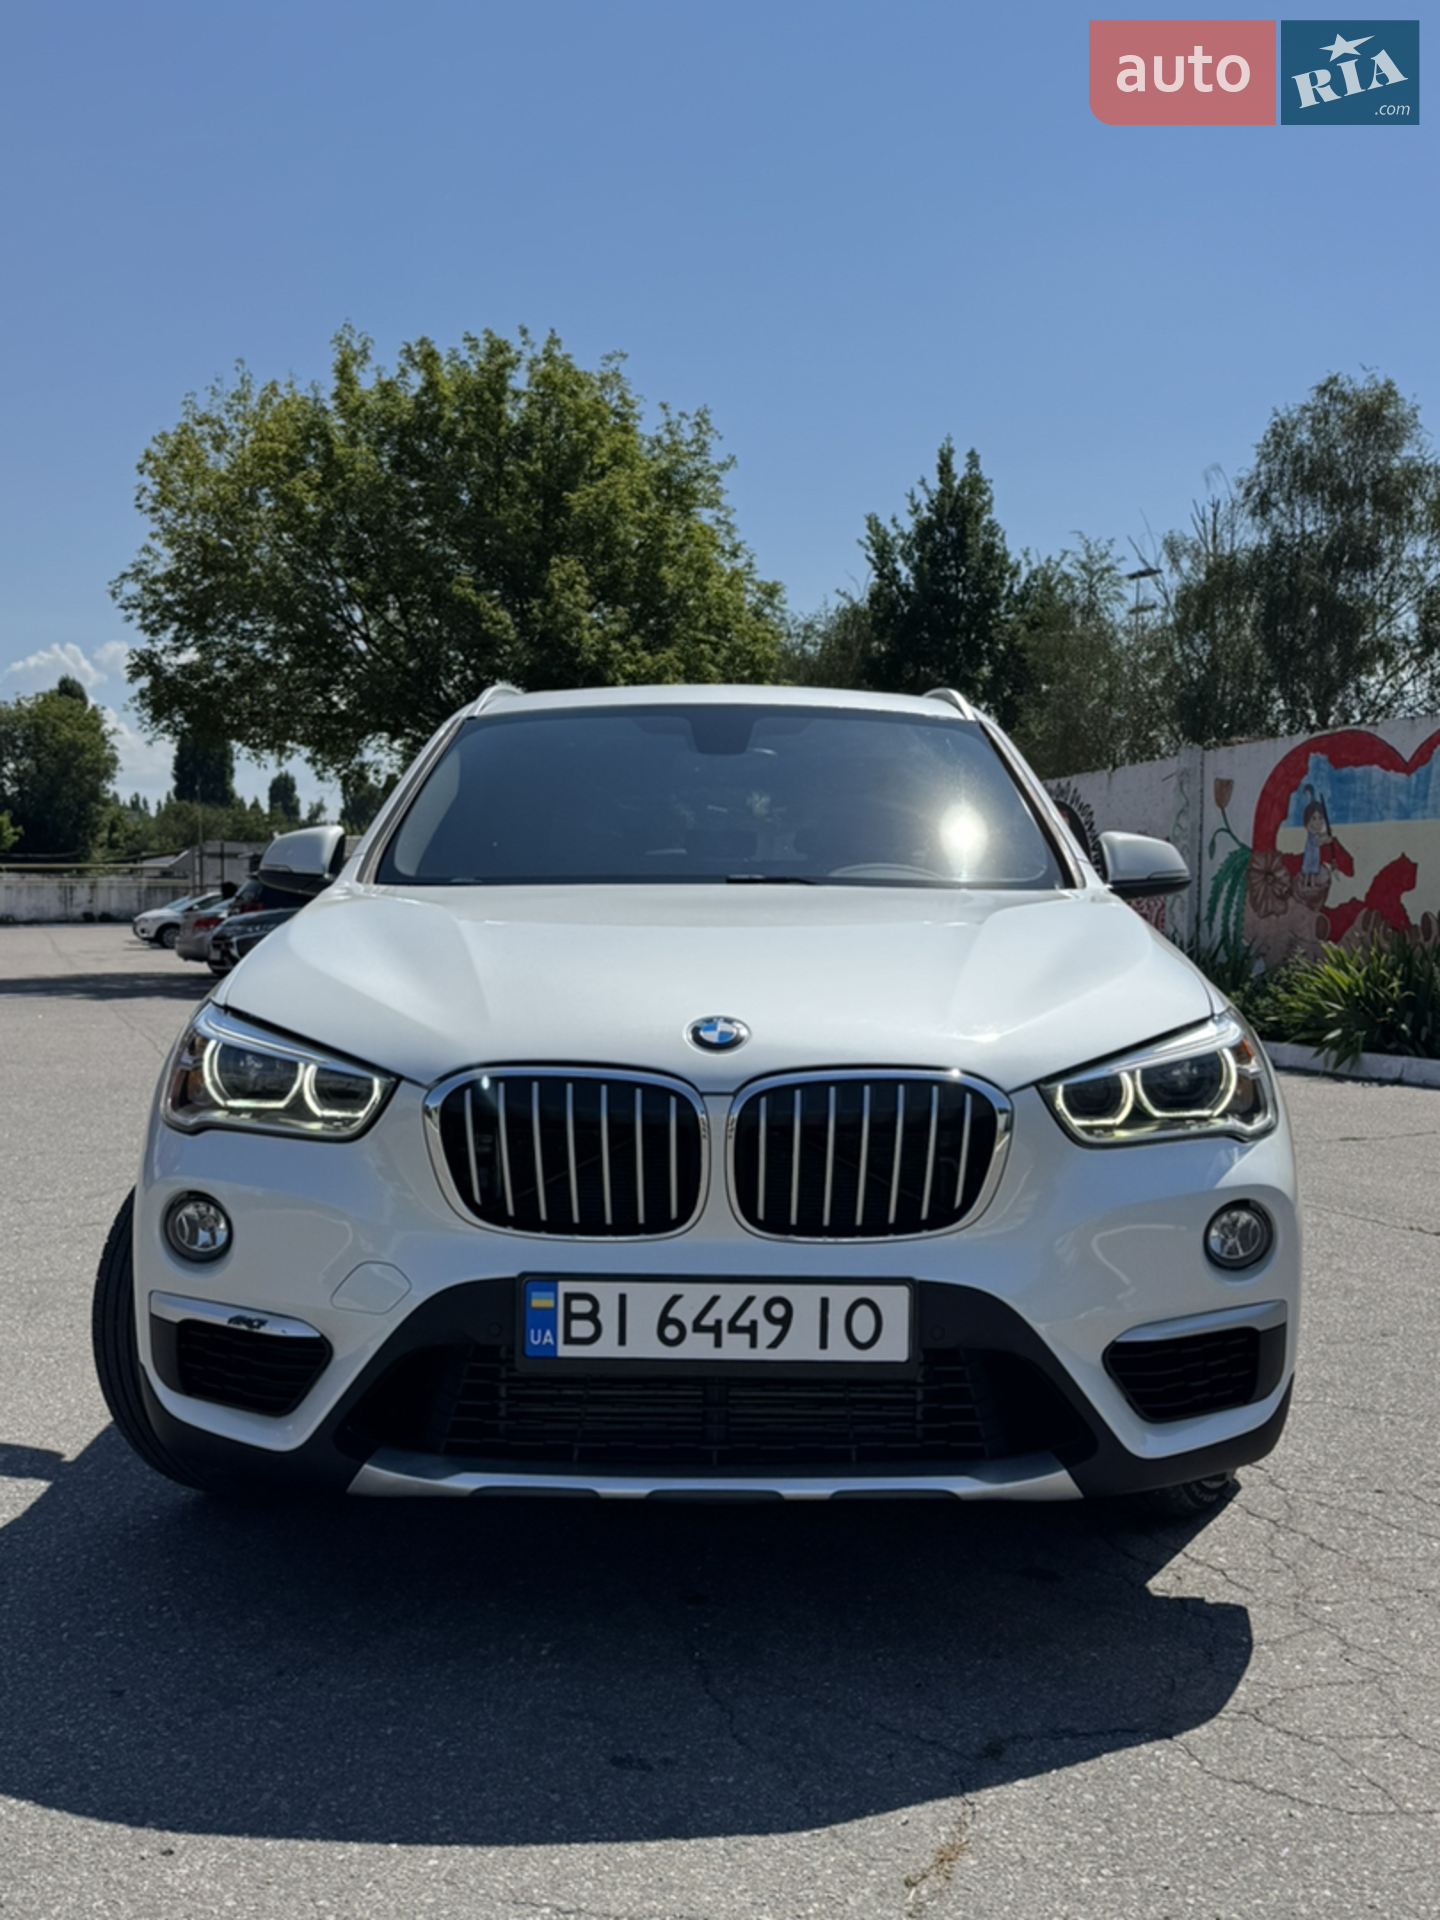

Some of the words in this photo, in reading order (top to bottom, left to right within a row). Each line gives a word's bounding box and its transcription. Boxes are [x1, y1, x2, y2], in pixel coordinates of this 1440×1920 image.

[530, 1328, 554, 1346] UA
[563, 1292, 627, 1346] BI
[656, 1294, 794, 1349] 6449
[819, 1297, 883, 1350] IO
